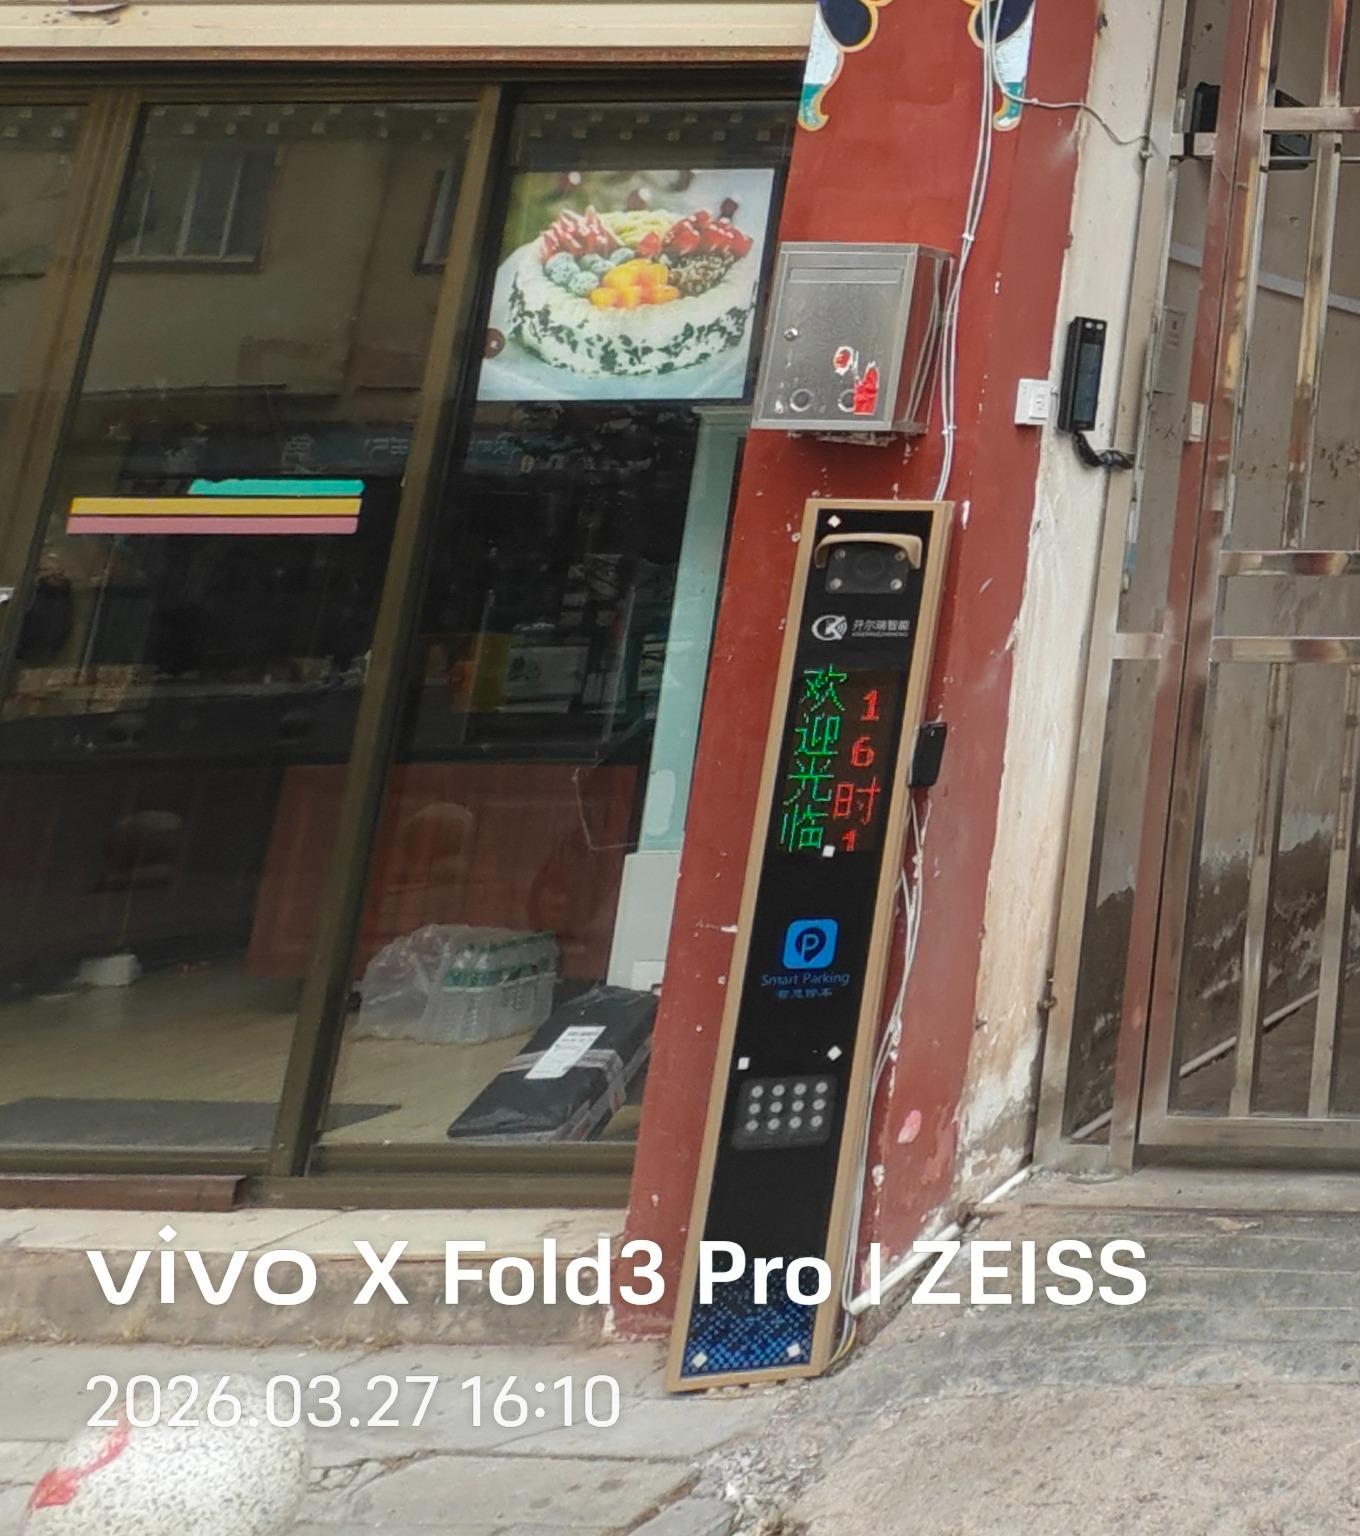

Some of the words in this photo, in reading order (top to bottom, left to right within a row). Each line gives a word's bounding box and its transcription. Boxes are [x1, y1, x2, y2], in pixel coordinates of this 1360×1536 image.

[779, 663, 848, 853] 欢迎光临
[761, 974, 798, 987] Smart
[802, 971, 850, 987] Parking
